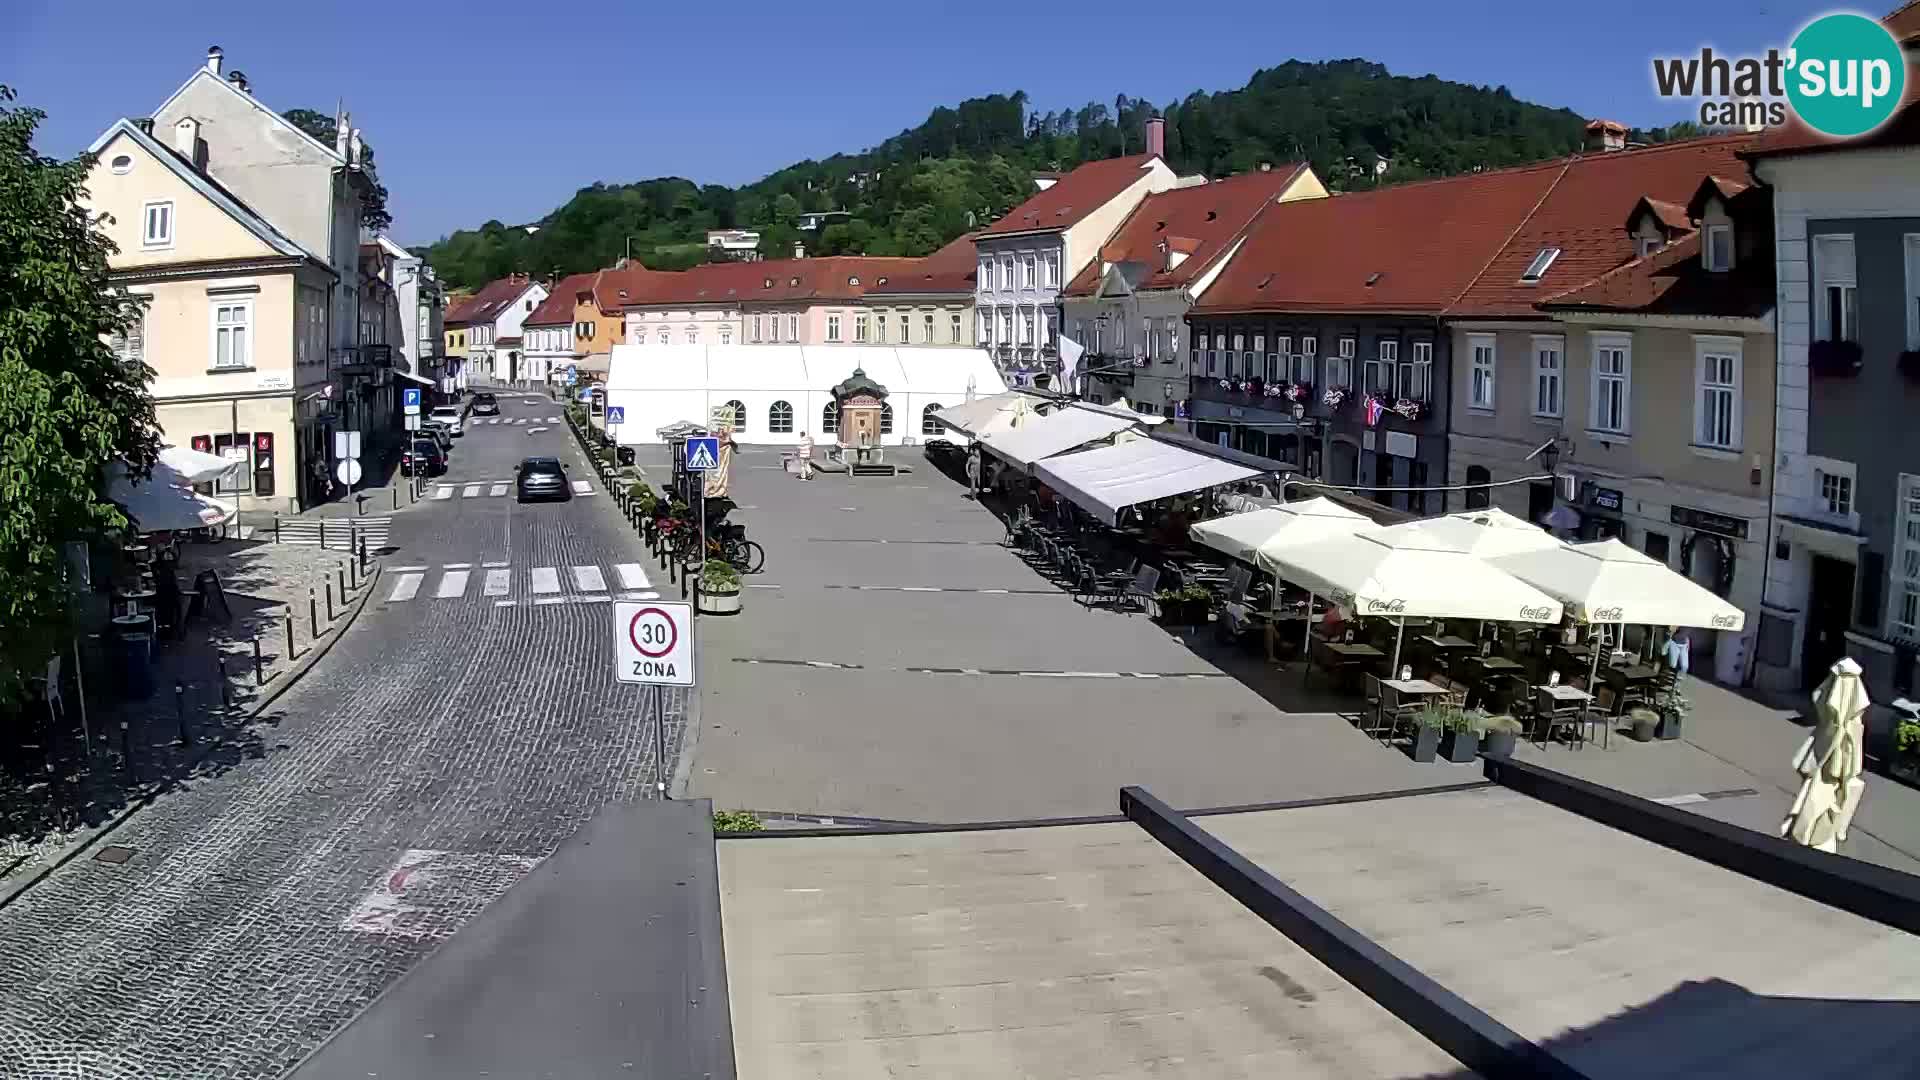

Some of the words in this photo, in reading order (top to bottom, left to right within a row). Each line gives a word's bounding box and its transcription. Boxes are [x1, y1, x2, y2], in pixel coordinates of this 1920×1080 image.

[408, 392, 416, 403] P
[642, 623, 666, 644] 30
[632, 660, 677, 678] ZONA
